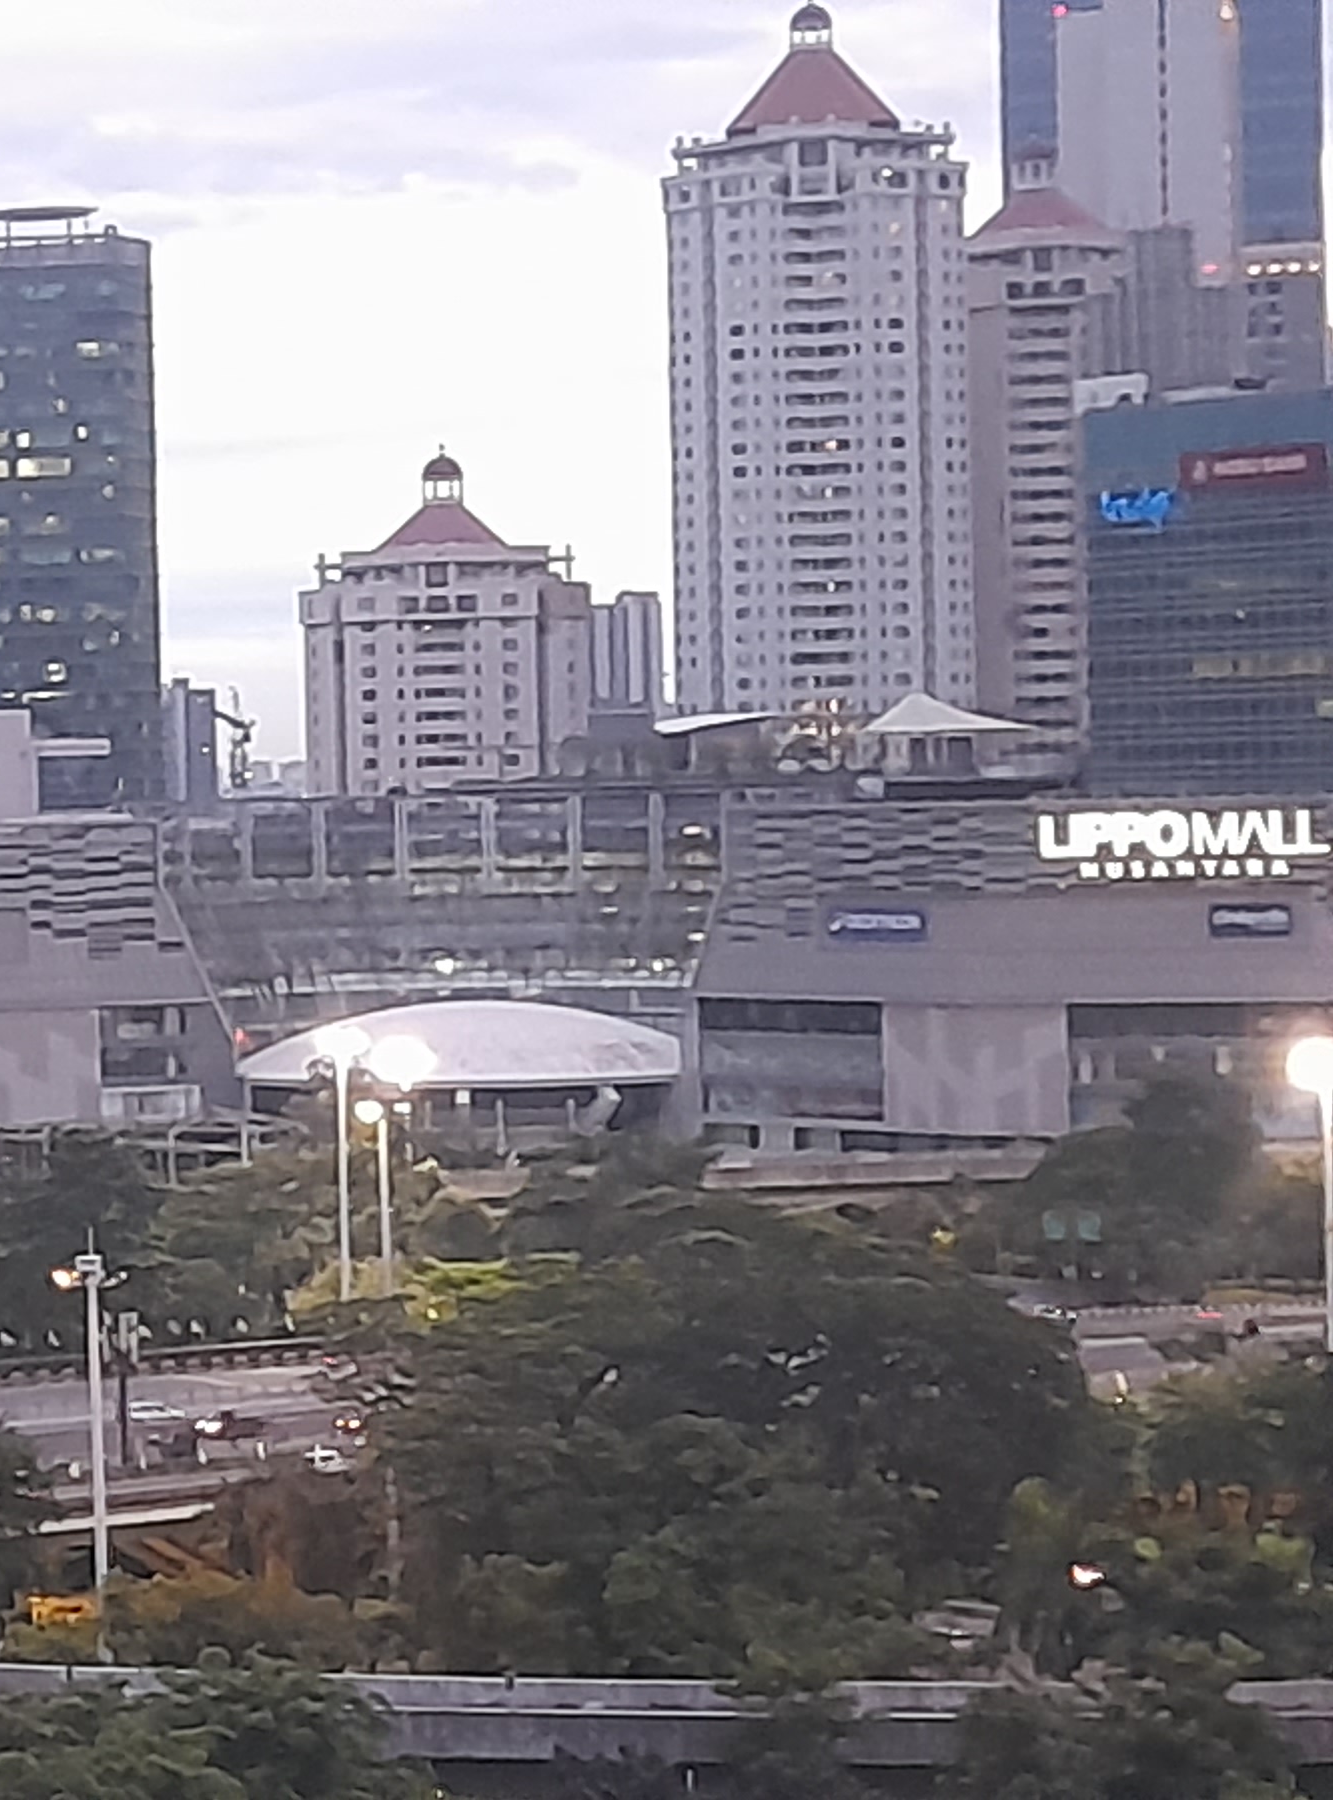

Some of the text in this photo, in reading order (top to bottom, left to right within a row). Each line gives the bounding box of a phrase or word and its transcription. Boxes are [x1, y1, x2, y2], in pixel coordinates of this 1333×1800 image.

[1037, 808, 1332, 858] LIPPO MALL
[1078, 859, 1291, 880] NUSANTARA
